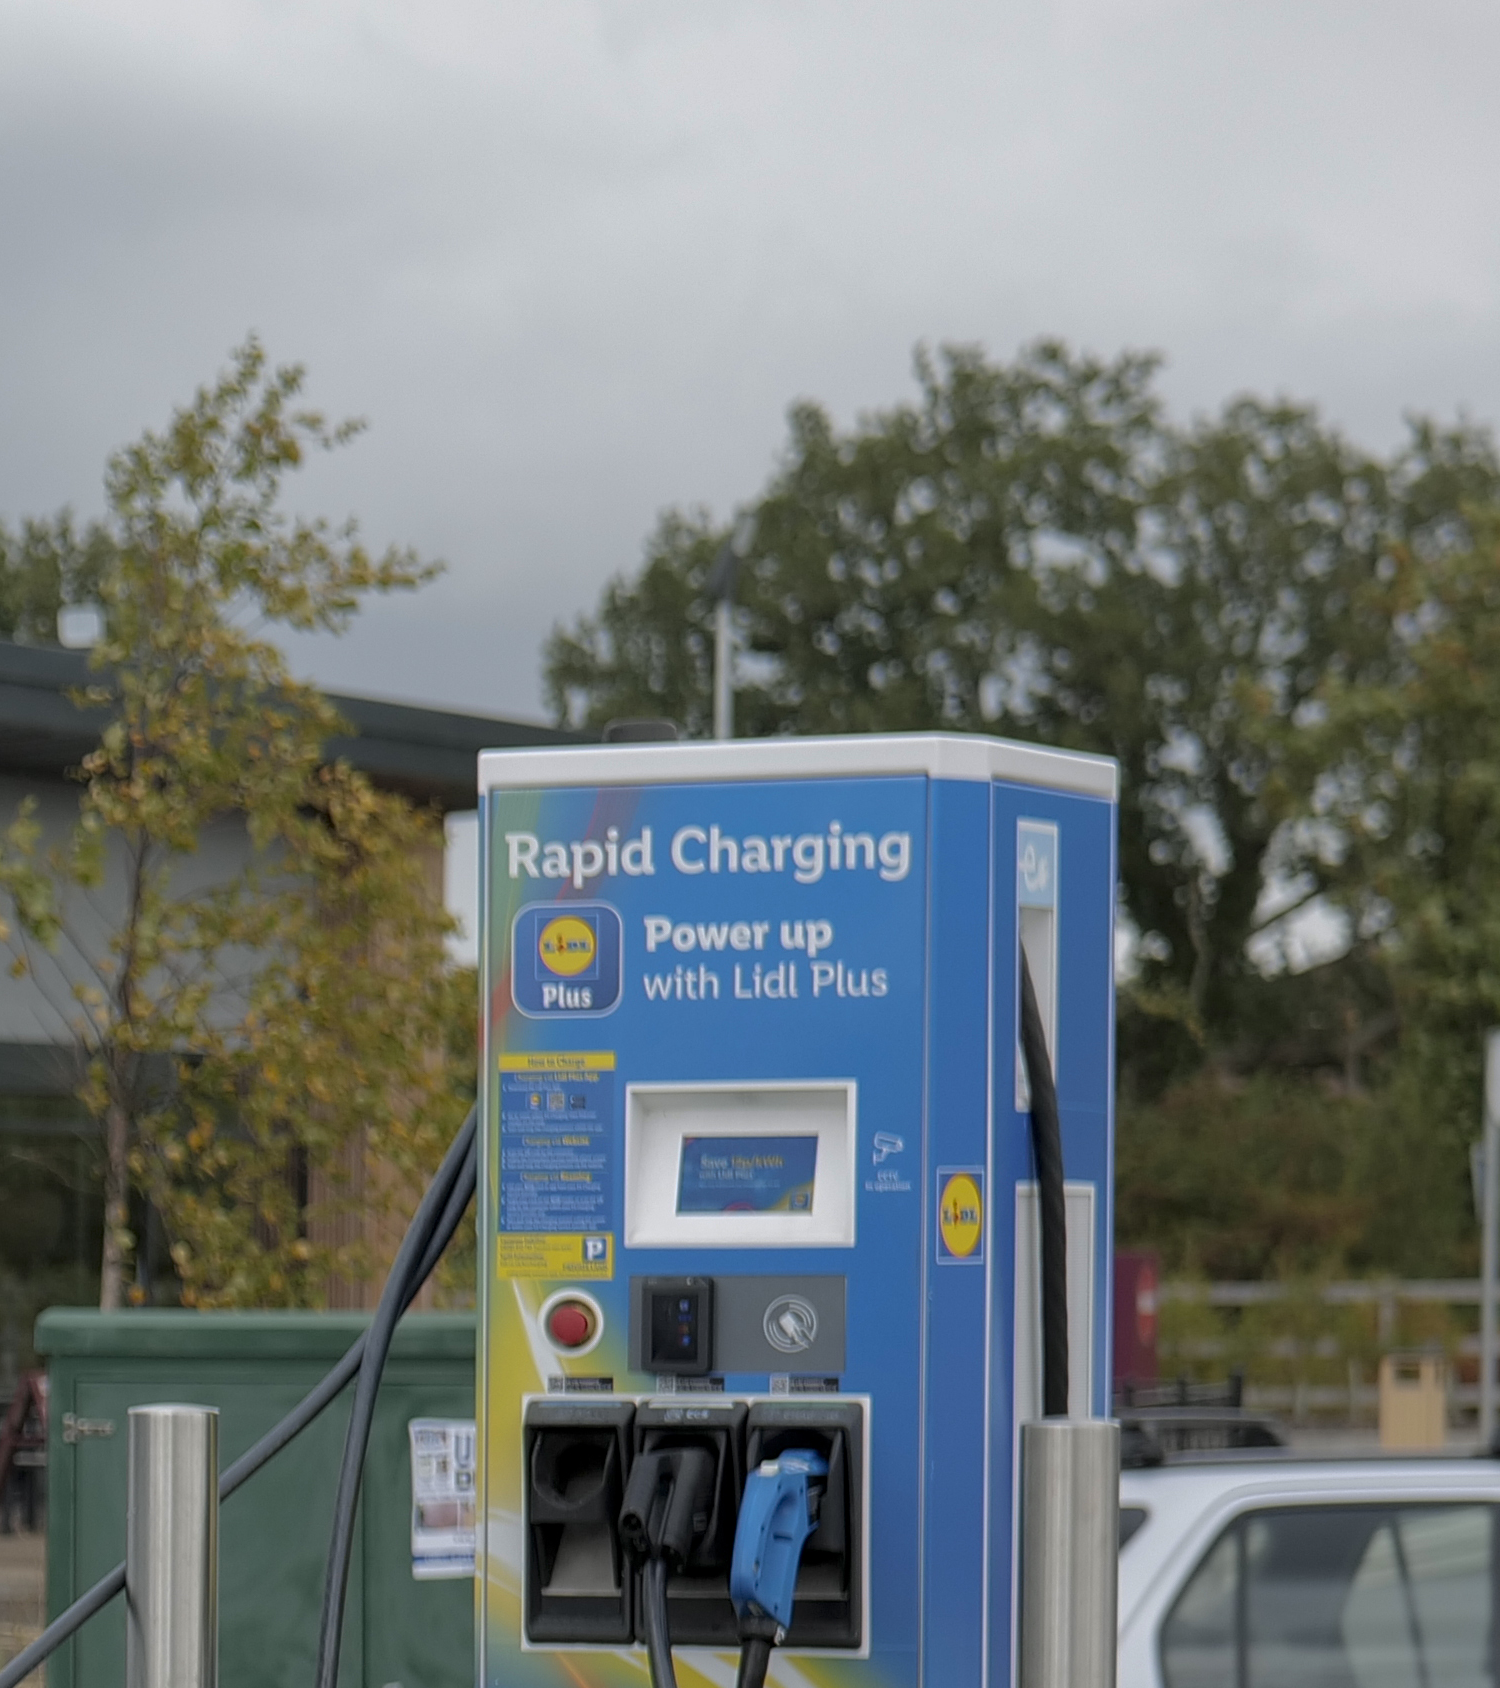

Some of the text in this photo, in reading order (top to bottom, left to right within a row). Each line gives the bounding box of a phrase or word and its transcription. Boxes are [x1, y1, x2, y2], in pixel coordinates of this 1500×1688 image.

[505, 820, 913, 888] Rapid Charging
[643, 916, 833, 956] Power up
[542, 981, 592, 1009] Plus
[644, 960, 889, 1000] with Lidl Plus
